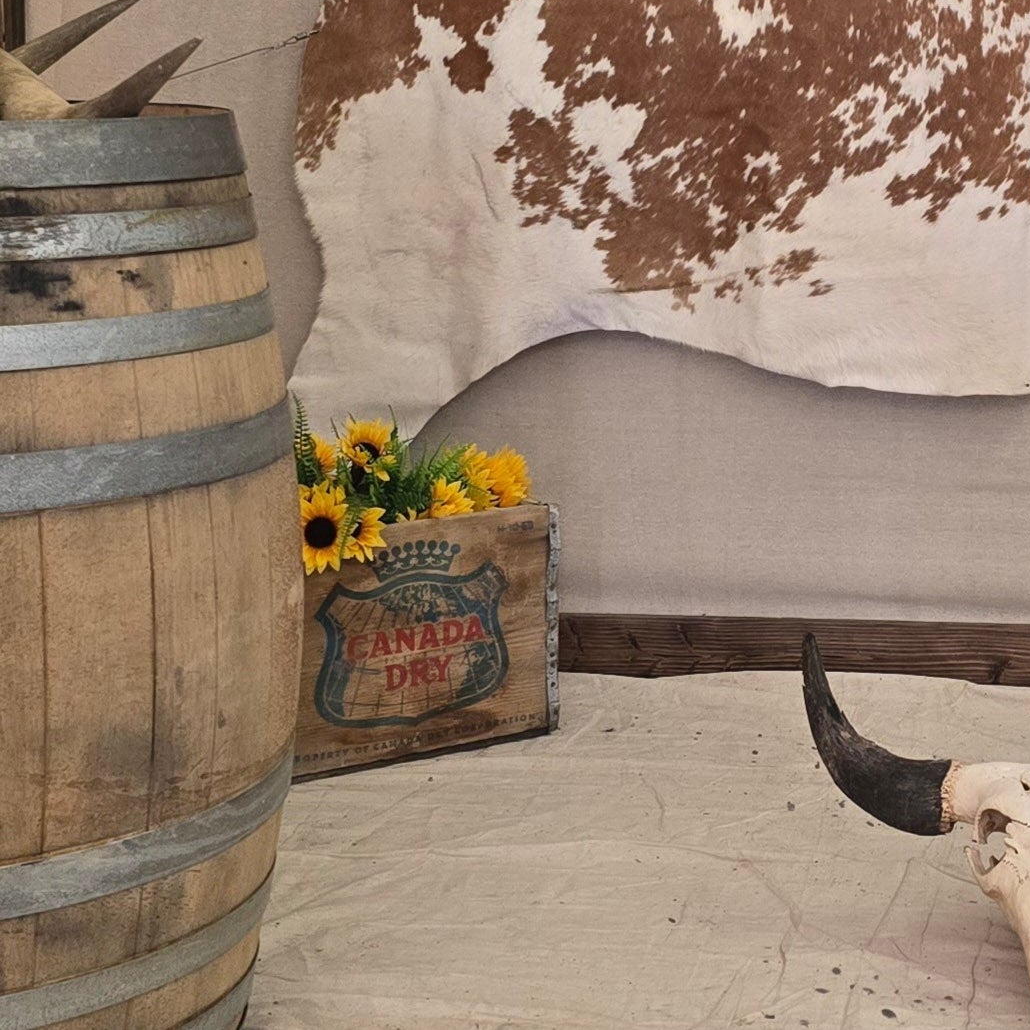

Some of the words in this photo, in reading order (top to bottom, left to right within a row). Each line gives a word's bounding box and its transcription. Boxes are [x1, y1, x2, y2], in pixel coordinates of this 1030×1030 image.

[347, 615, 486, 660] CANADA
[385, 654, 452, 690] DRY
[355, 745, 370, 755] OF
